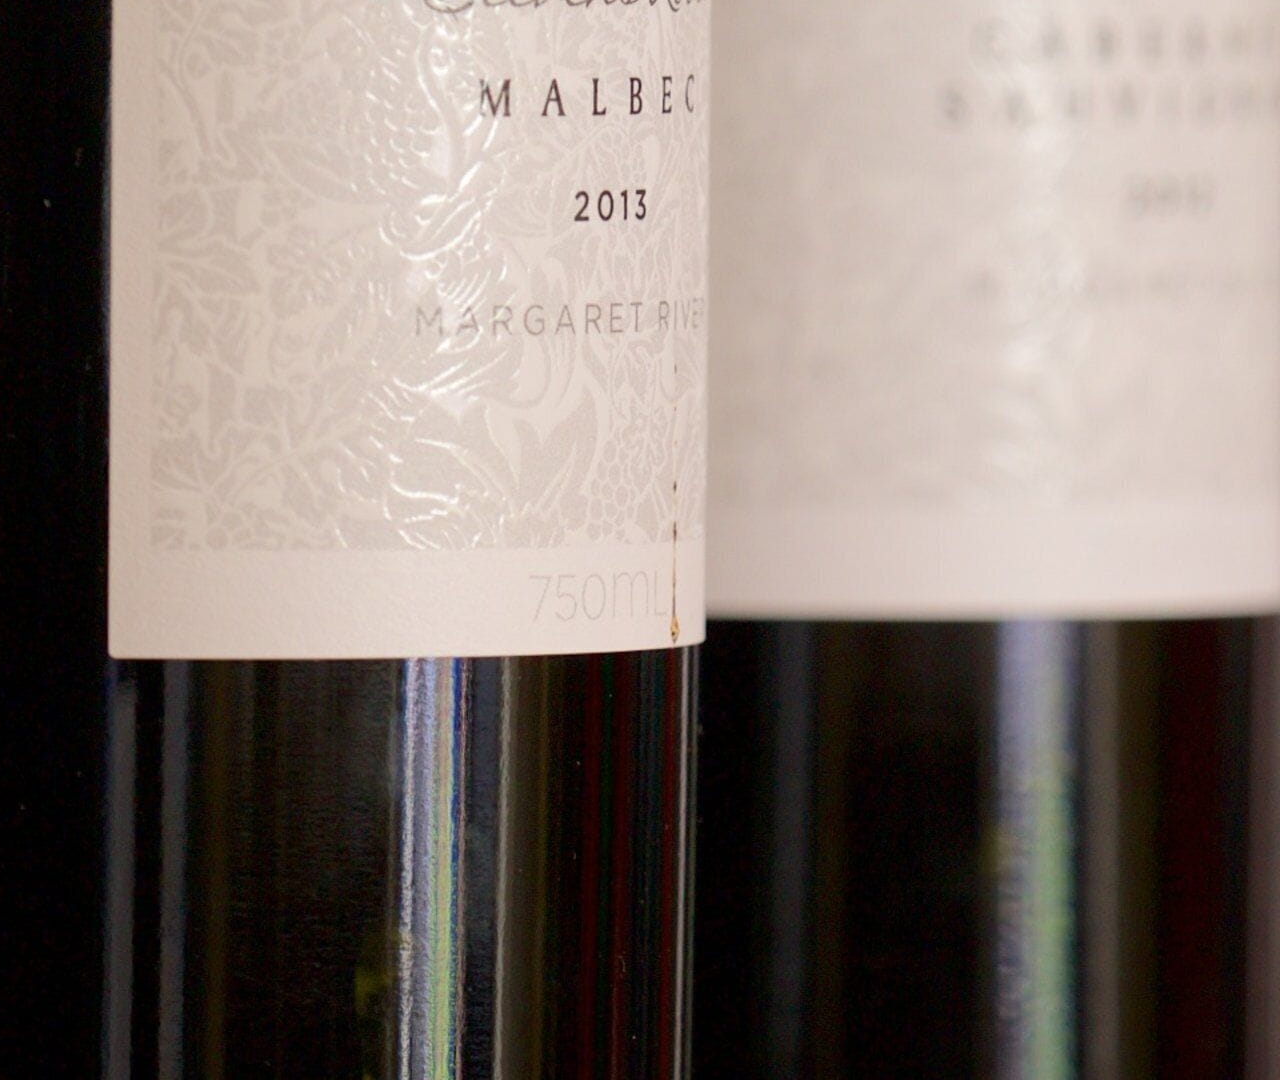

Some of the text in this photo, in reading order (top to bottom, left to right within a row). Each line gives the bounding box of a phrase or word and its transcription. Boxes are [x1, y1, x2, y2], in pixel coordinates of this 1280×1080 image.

[478, 74, 696, 118] MALBEC
[572, 188, 648, 222] 2013
[414, 301, 643, 338] MARGARET
